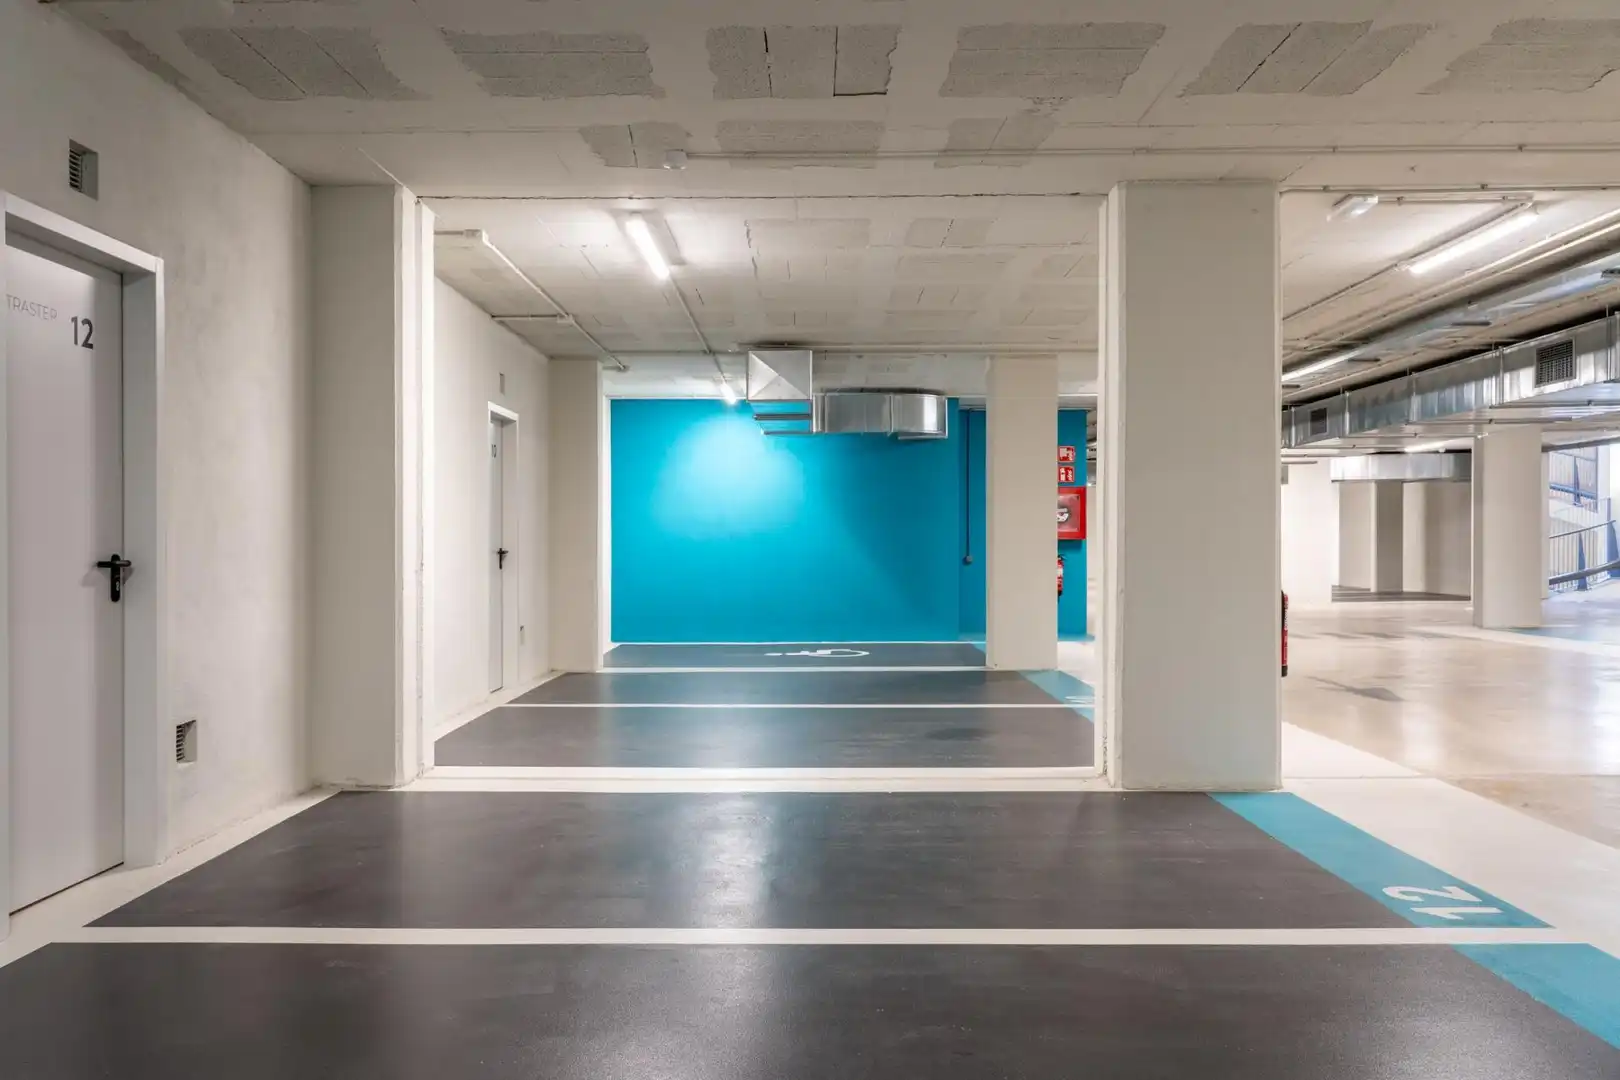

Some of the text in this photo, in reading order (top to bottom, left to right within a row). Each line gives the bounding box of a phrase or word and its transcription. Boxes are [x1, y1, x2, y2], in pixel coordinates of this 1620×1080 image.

[6, 293, 94, 350] TRASTER 12
[1382, 885, 1504, 920] 12
